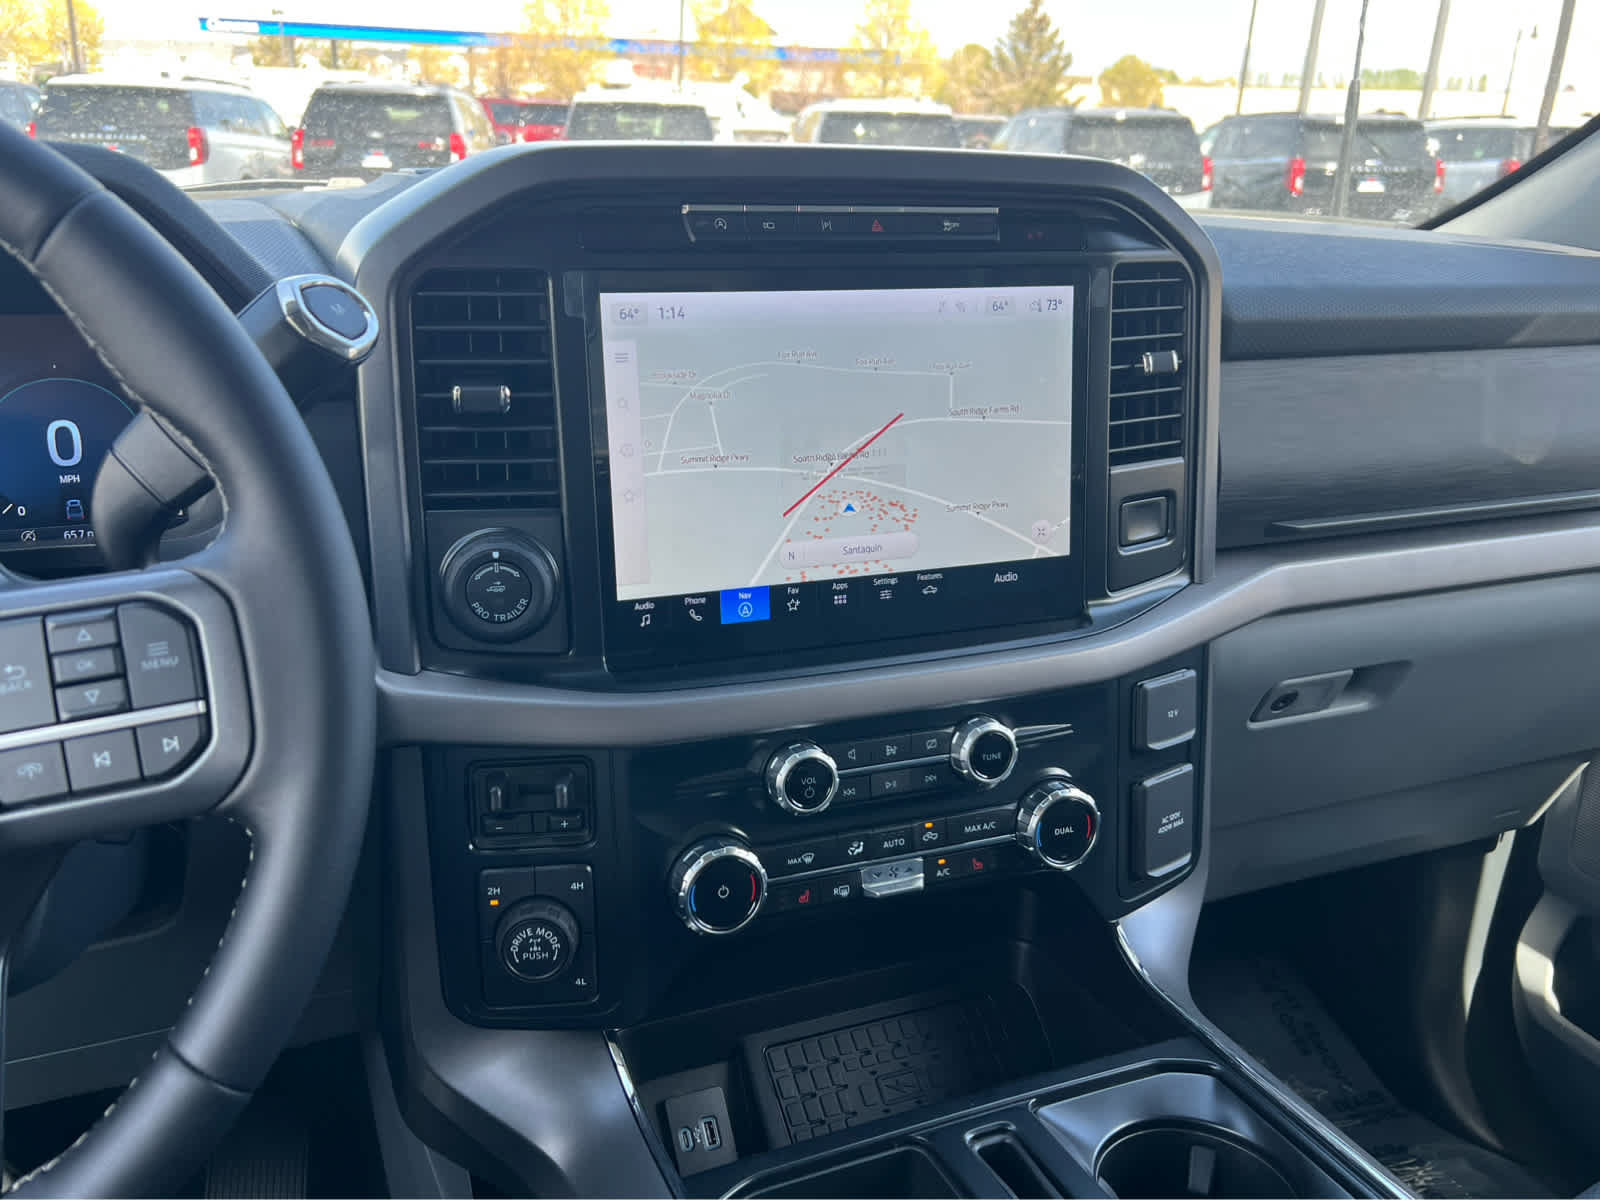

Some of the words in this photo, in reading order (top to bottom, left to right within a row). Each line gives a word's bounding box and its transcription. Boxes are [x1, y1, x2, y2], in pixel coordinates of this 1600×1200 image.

[657, 306, 685, 320] 1:14
[47, 419, 83, 467] 0
[681, 456, 708, 464] Summit
[710, 454, 729, 464] Ridge
[793, 454, 815, 463] South
[59, 474, 81, 485] MPH
[17, 505, 27, 517] 0
[842, 542, 883, 556] Santaquin
[788, 551, 795, 560] N
[873, 576, 898, 587] Settings
[916, 572, 943, 581] Features
[994, 571, 1018, 583] Audio
[832, 581, 849, 591] Apps
[738, 591, 752, 599] Nav
[634, 602, 654, 610] Audio
[684, 597, 706, 606] Phone
[471, 602, 490, 619] PRO
[494, 598, 529, 621] TRAILER
[140, 656, 179, 671] MENU
[982, 752, 1001, 761] TUNE
[800, 777, 816, 785] VOL
[964, 824, 981, 833] MAX
[982, 821, 996, 831] A/C
[1054, 826, 1074, 836] DUAL
[883, 838, 905, 849] AUTO
[787, 856, 802, 865] MAX
[936, 868, 951, 877] A/C
[487, 887, 501, 896] 2H
[570, 882, 584, 891] 4H
[510, 927, 533, 952] DRIVE
[536, 927, 560, 951] MODE
[522, 951, 549, 960] PUSH
[575, 977, 587, 986] 4L
